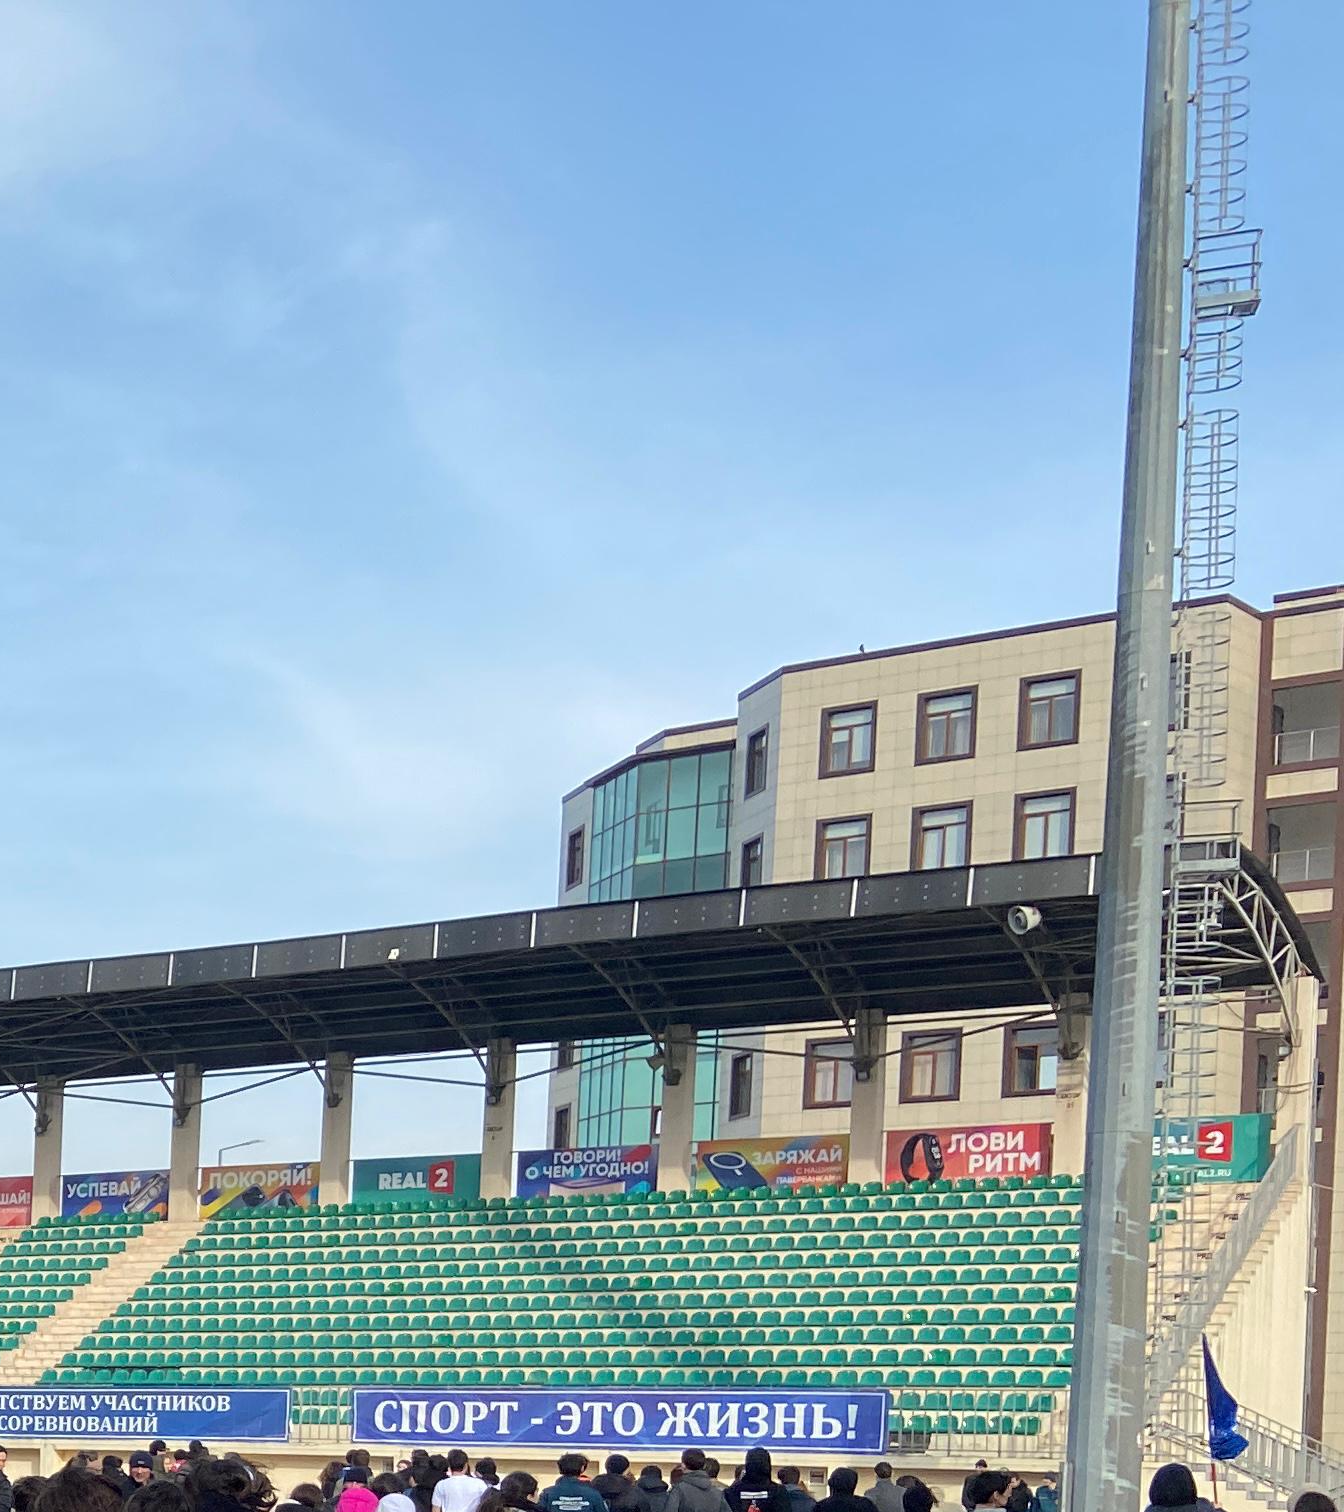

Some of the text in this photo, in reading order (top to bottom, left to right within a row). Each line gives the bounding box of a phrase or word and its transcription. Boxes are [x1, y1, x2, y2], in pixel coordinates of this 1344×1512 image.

[947, 1130, 1025, 1153] ЛОВИ
[1152, 1130, 1225, 1156] EAL 2
[553, 1150, 622, 1164] ГОВОРИ!
[752, 1145, 843, 1165] ЗАРЯЖАЙ
[968, 1151, 1041, 1174] РИТМ
[209, 1166, 313, 1190] ПОКОРЯЙ!
[378, 1167, 449, 1190] REAL 2
[525, 1161, 650, 1180] О ЧЕМ УГОДНО!
[66, 1177, 142, 1198] УСПЕВАЙ
[91, 1394, 231, 1413] УЧАСТНИКОВ
[374, 1400, 519, 1436] СПОРТ
[554, 1403, 645, 1437] ЭТО
[657, 1402, 859, 1442] ЖИЗНЬ!
